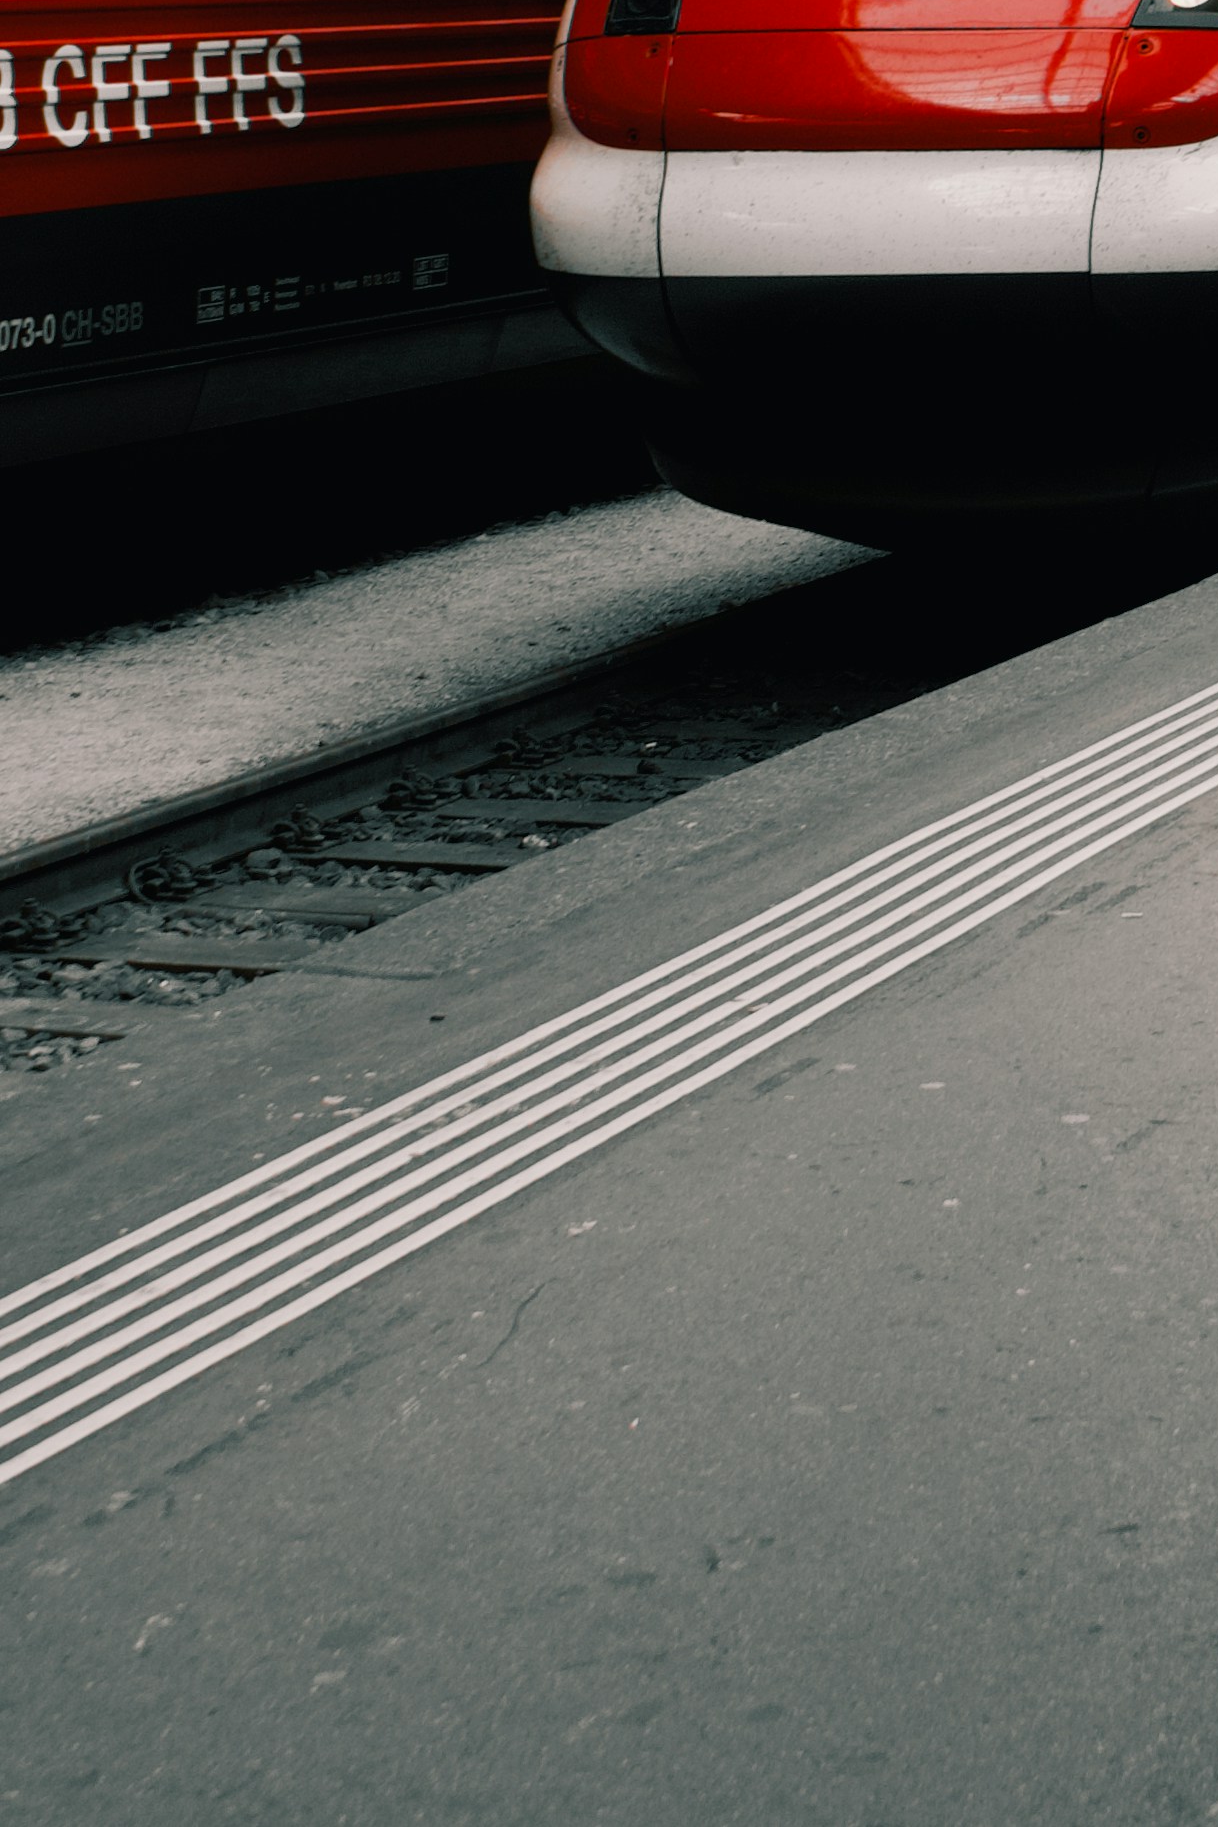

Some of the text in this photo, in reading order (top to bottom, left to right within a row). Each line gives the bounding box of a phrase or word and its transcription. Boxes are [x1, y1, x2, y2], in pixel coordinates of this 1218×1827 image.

[42, 42, 172, 148] CFF
[193, 34, 306, 134] FFS
[61, 301, 144, 343] CH-SBB
